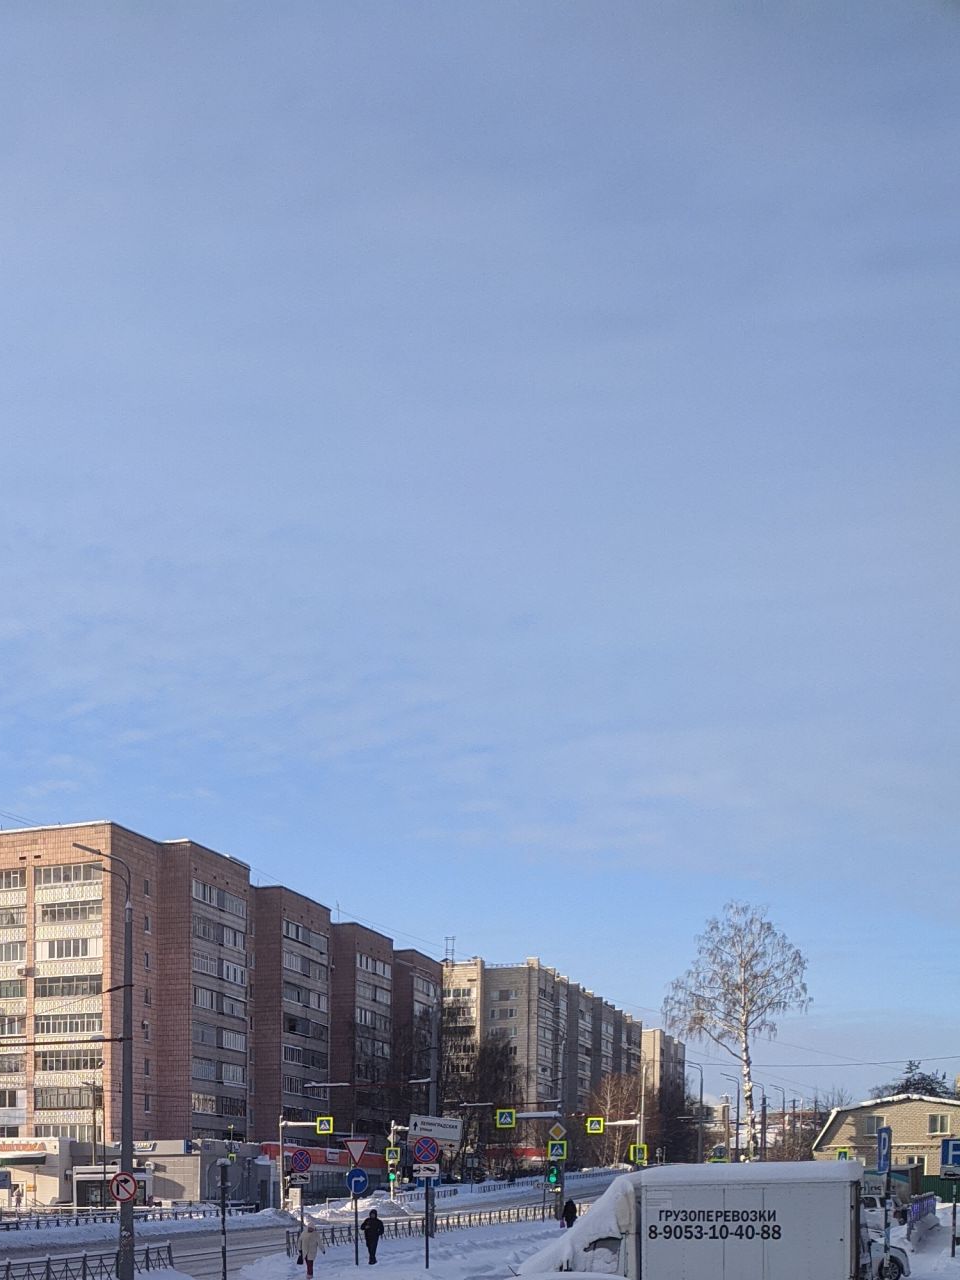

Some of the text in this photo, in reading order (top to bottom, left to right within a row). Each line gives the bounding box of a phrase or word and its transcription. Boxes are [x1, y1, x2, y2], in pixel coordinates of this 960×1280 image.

[880, 1132, 889, 1167] P
[658, 1209, 777, 1222] ГРУЗОПЕРЕВОЗКИ
[648, 1224, 782, 1240] 8-9053-10-40-88
